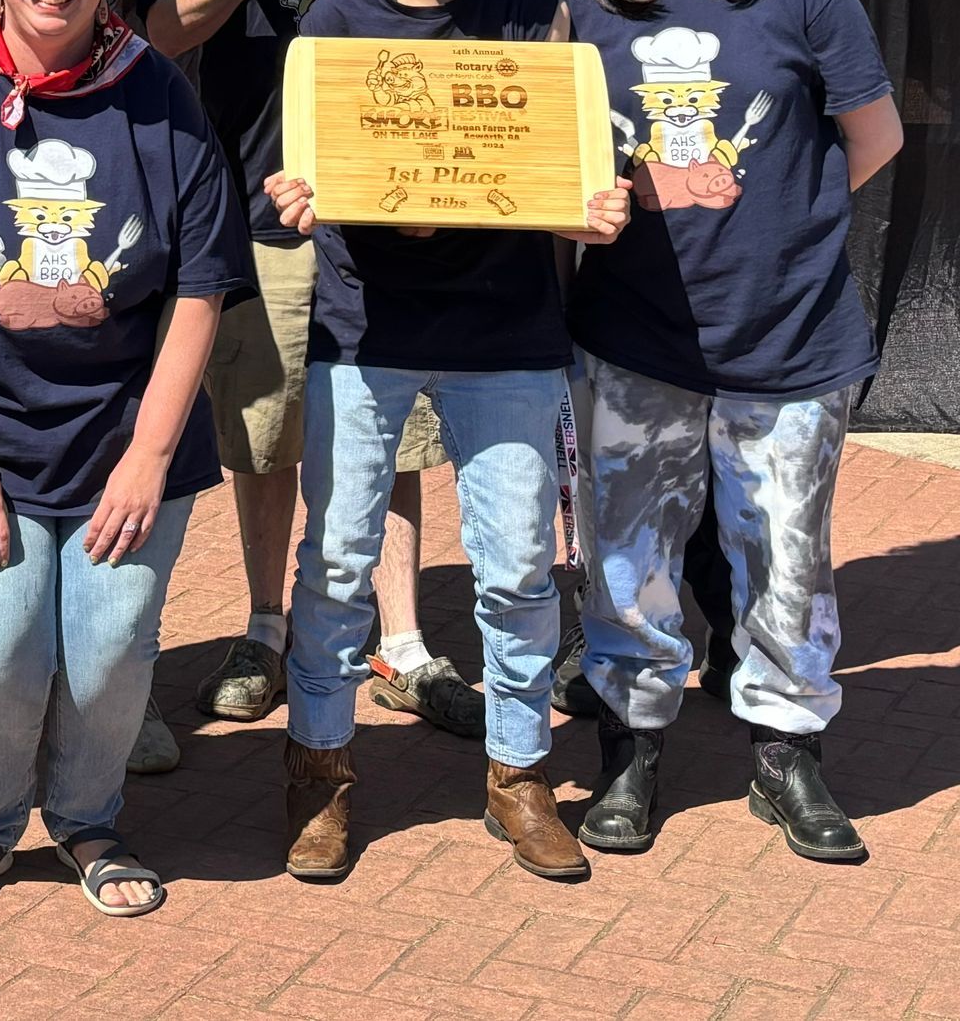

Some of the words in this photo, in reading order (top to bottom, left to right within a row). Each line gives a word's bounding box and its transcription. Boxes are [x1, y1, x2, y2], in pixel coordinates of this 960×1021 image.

[452, 48, 470, 56] 14th
[472, 48, 504, 56] Annual
[455, 62, 493, 72] Rotary
[451, 83, 528, 111] BBQ
[360, 110, 442, 130] SMOKE
[452, 110, 516, 122] FESTIVAL
[452, 124, 481, 132] Logan
[482, 125, 507, 133] Farm
[508, 125, 531, 133] Park
[372, 131, 387, 139] ON
[390, 131, 410, 140] THE
[412, 132, 439, 140] LAKE
[670, 135, 696, 147] AHS
[671, 148, 701, 161] BBQ
[386, 166, 422, 184] 1st
[431, 166, 507, 185] Place
[428, 196, 468, 209] Ribs
[40, 254, 68, 266] AHS
[40, 267, 73, 280] BBQ
